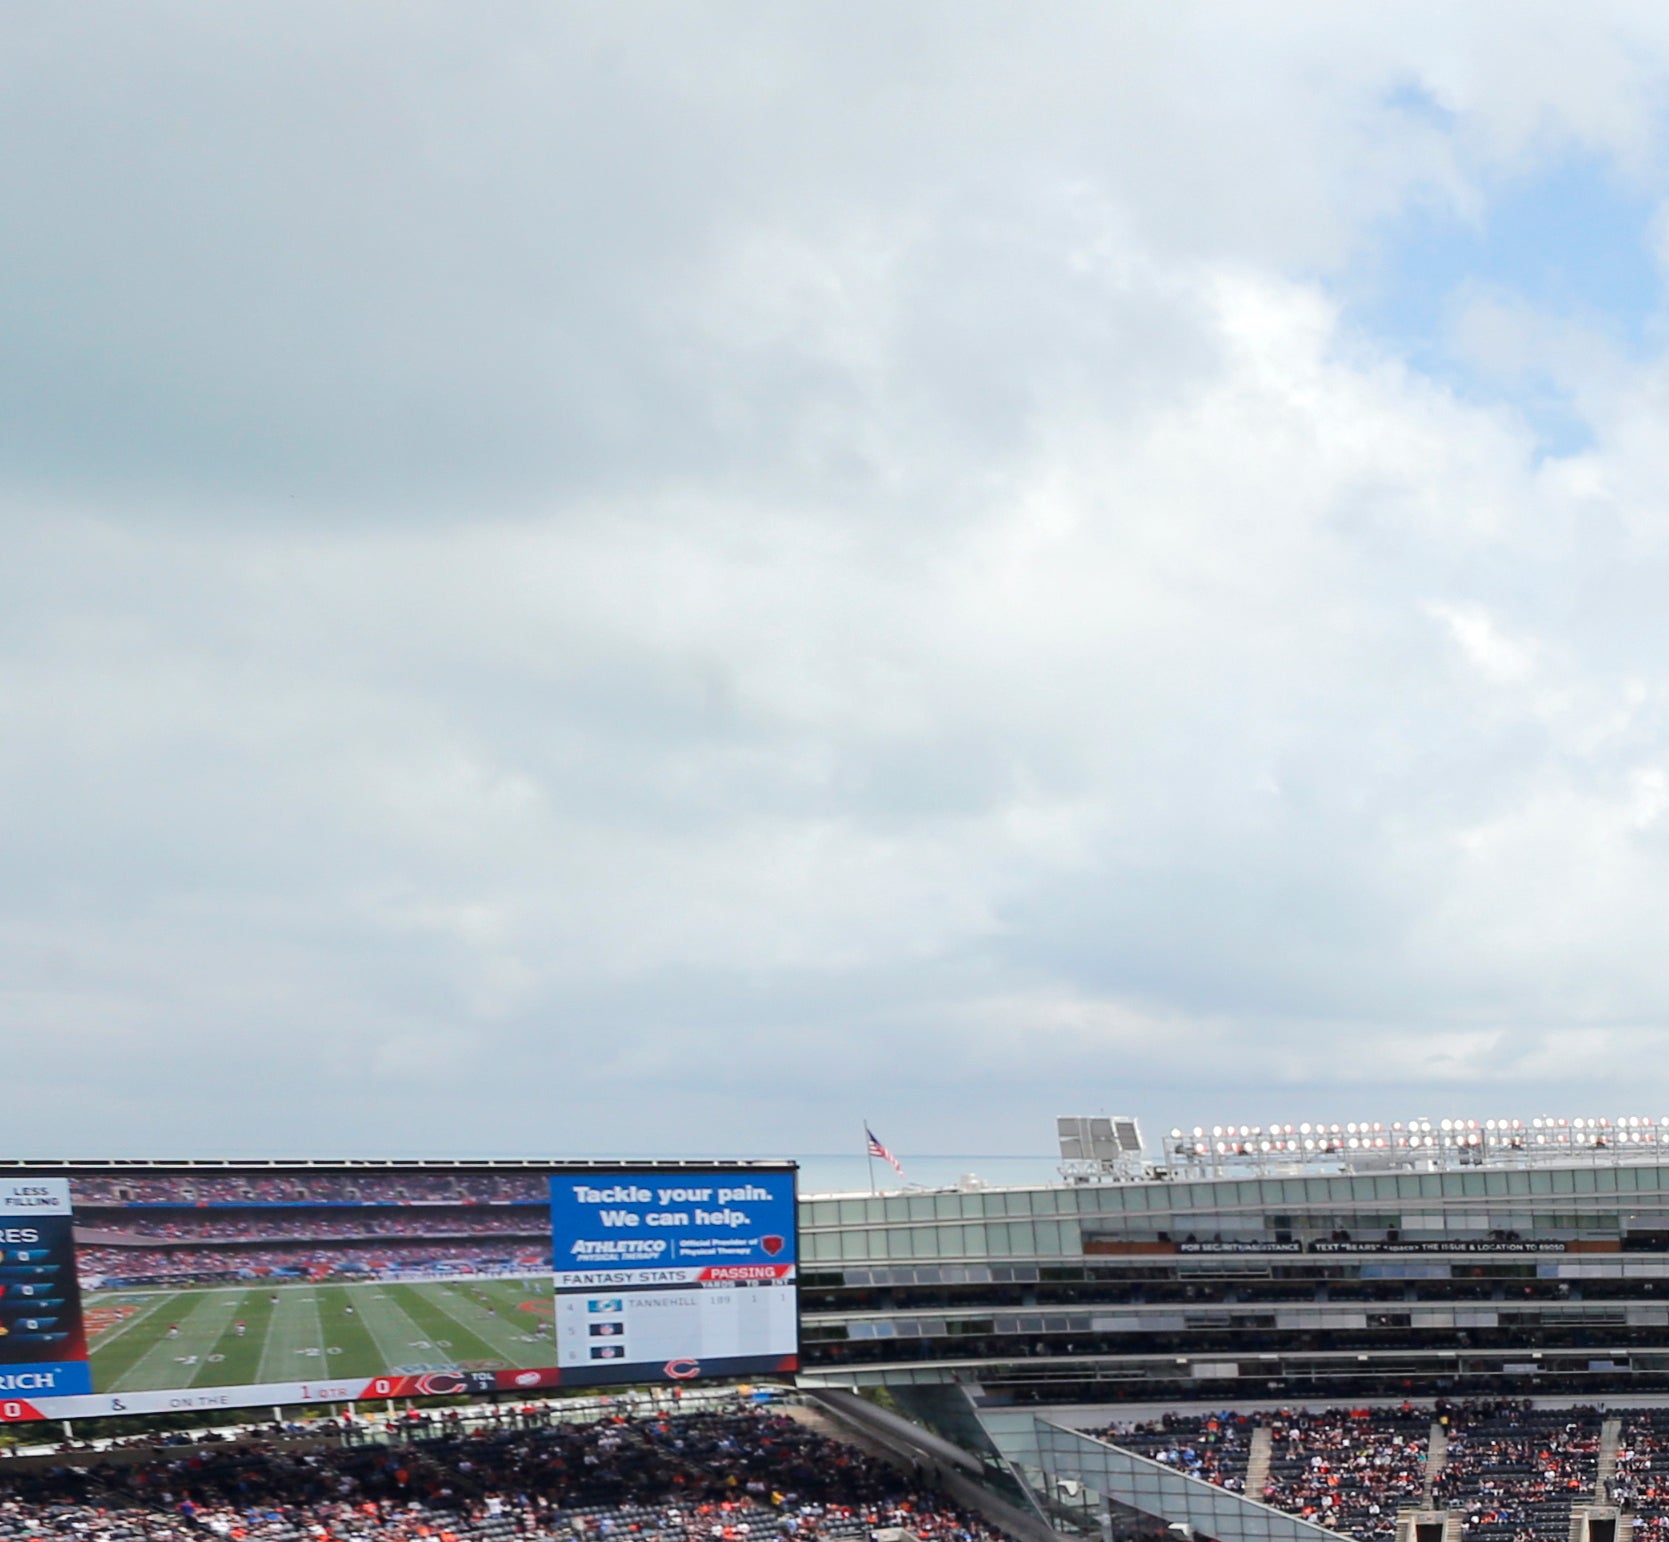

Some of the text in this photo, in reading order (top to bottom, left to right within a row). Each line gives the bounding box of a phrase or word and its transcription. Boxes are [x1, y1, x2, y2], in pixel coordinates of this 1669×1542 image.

[12, 1186, 49, 1196] LESS
[573, 1185, 773, 1206] Tackle your pain.
[599, 1209, 751, 1229] We can help.
[570, 1239, 667, 1255] ATHLETICO
[679, 1238, 710, 1247] Official
[711, 1238, 747, 1247] Provider
[1181, 1243, 1200, 1251] FOR
[1316, 1243, 1338, 1251] TEXT
[1422, 1243, 1439, 1251] THE
[1441, 1243, 1466, 1251] ISSUE
[1477, 1243, 1523, 1251] LOCATION
[1525, 1243, 1537, 1251] TO
[679, 1247, 752, 1257] Physical Therapy
[563, 1270, 686, 1284] FANTASY STATS
[711, 1267, 776, 1279] PASSING
[629, 1297, 698, 1308] TANNEHILL
[4, 1402, 21, 1418] 0
[112, 1398, 126, 1411] &
[170, 1397, 192, 1408] ON
[198, 1395, 228, 1407] THE
[301, 1385, 312, 1399] 1
[317, 1388, 348, 1399] QTR
[375, 1380, 390, 1394] 0
